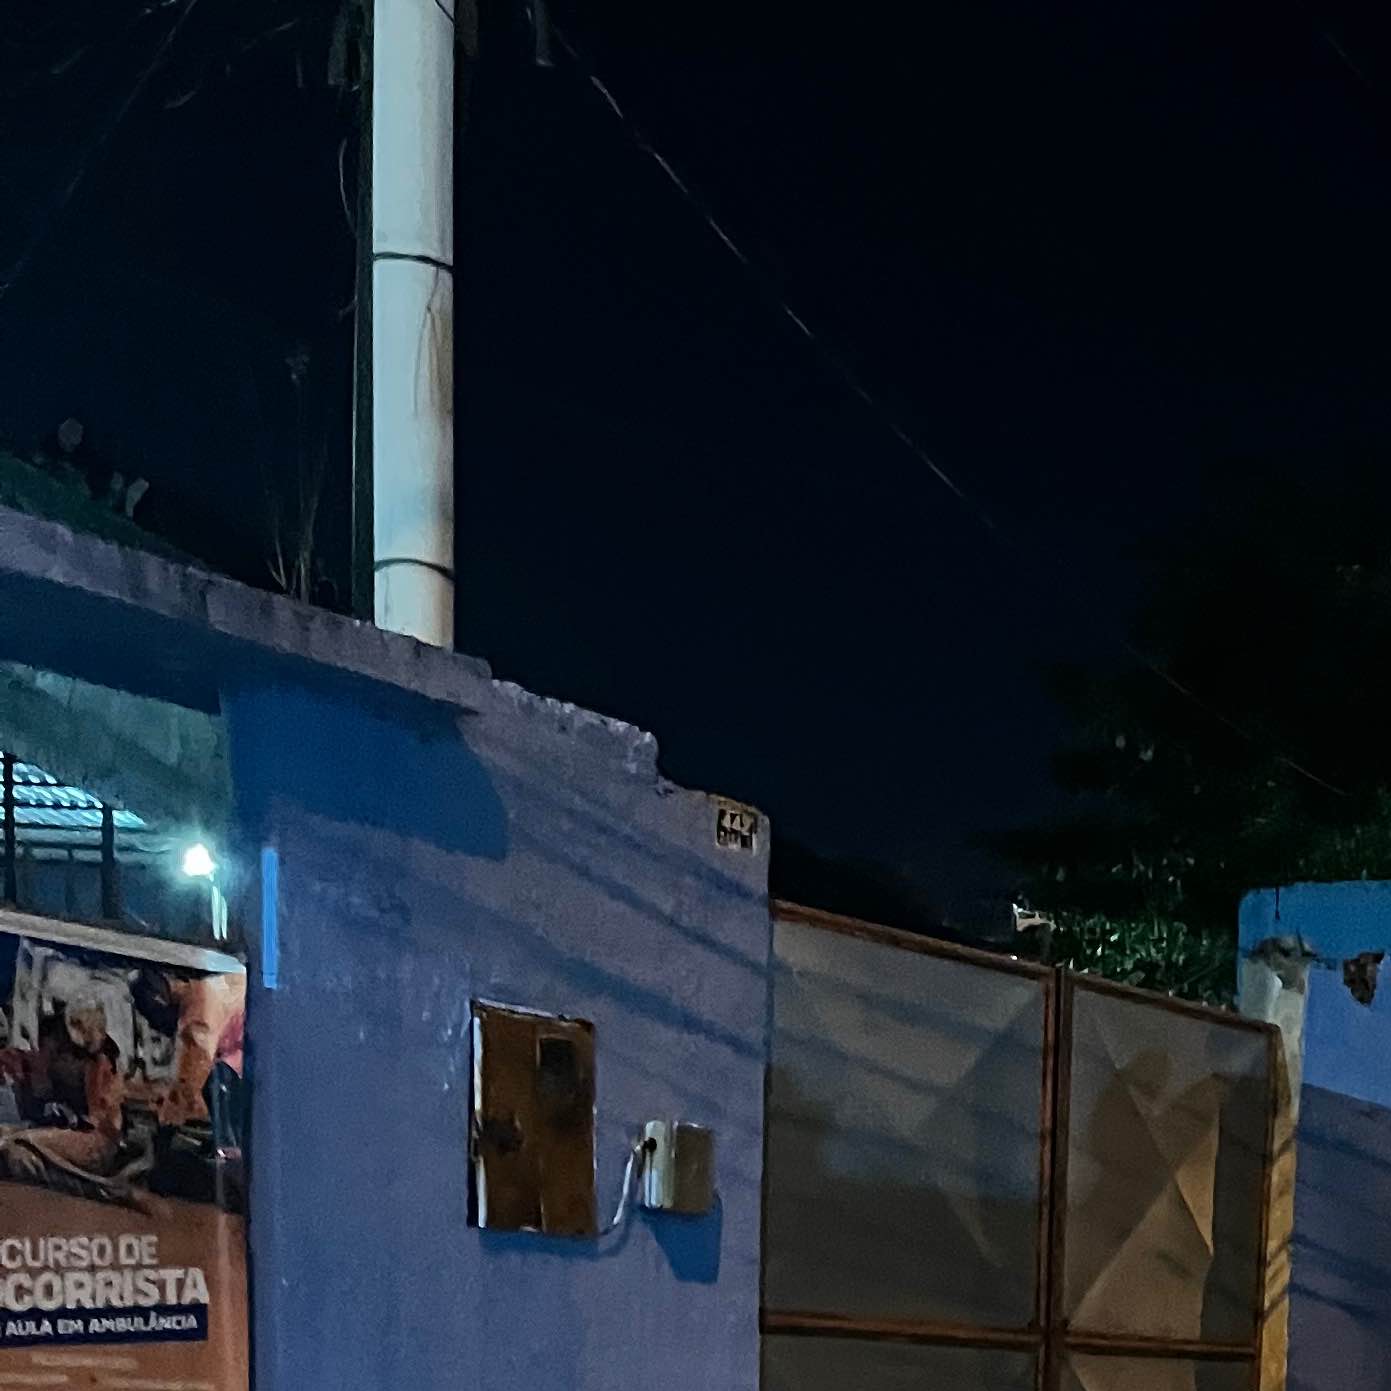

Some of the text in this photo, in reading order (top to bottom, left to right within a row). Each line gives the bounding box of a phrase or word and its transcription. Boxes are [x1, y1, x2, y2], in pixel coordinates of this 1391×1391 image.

[1, 1234, 159, 1268] CURSO DE
[0, 1267, 209, 1311] CORRISTA
[5, 1310, 198, 1336] AULA EM AMBULÂNCIA
